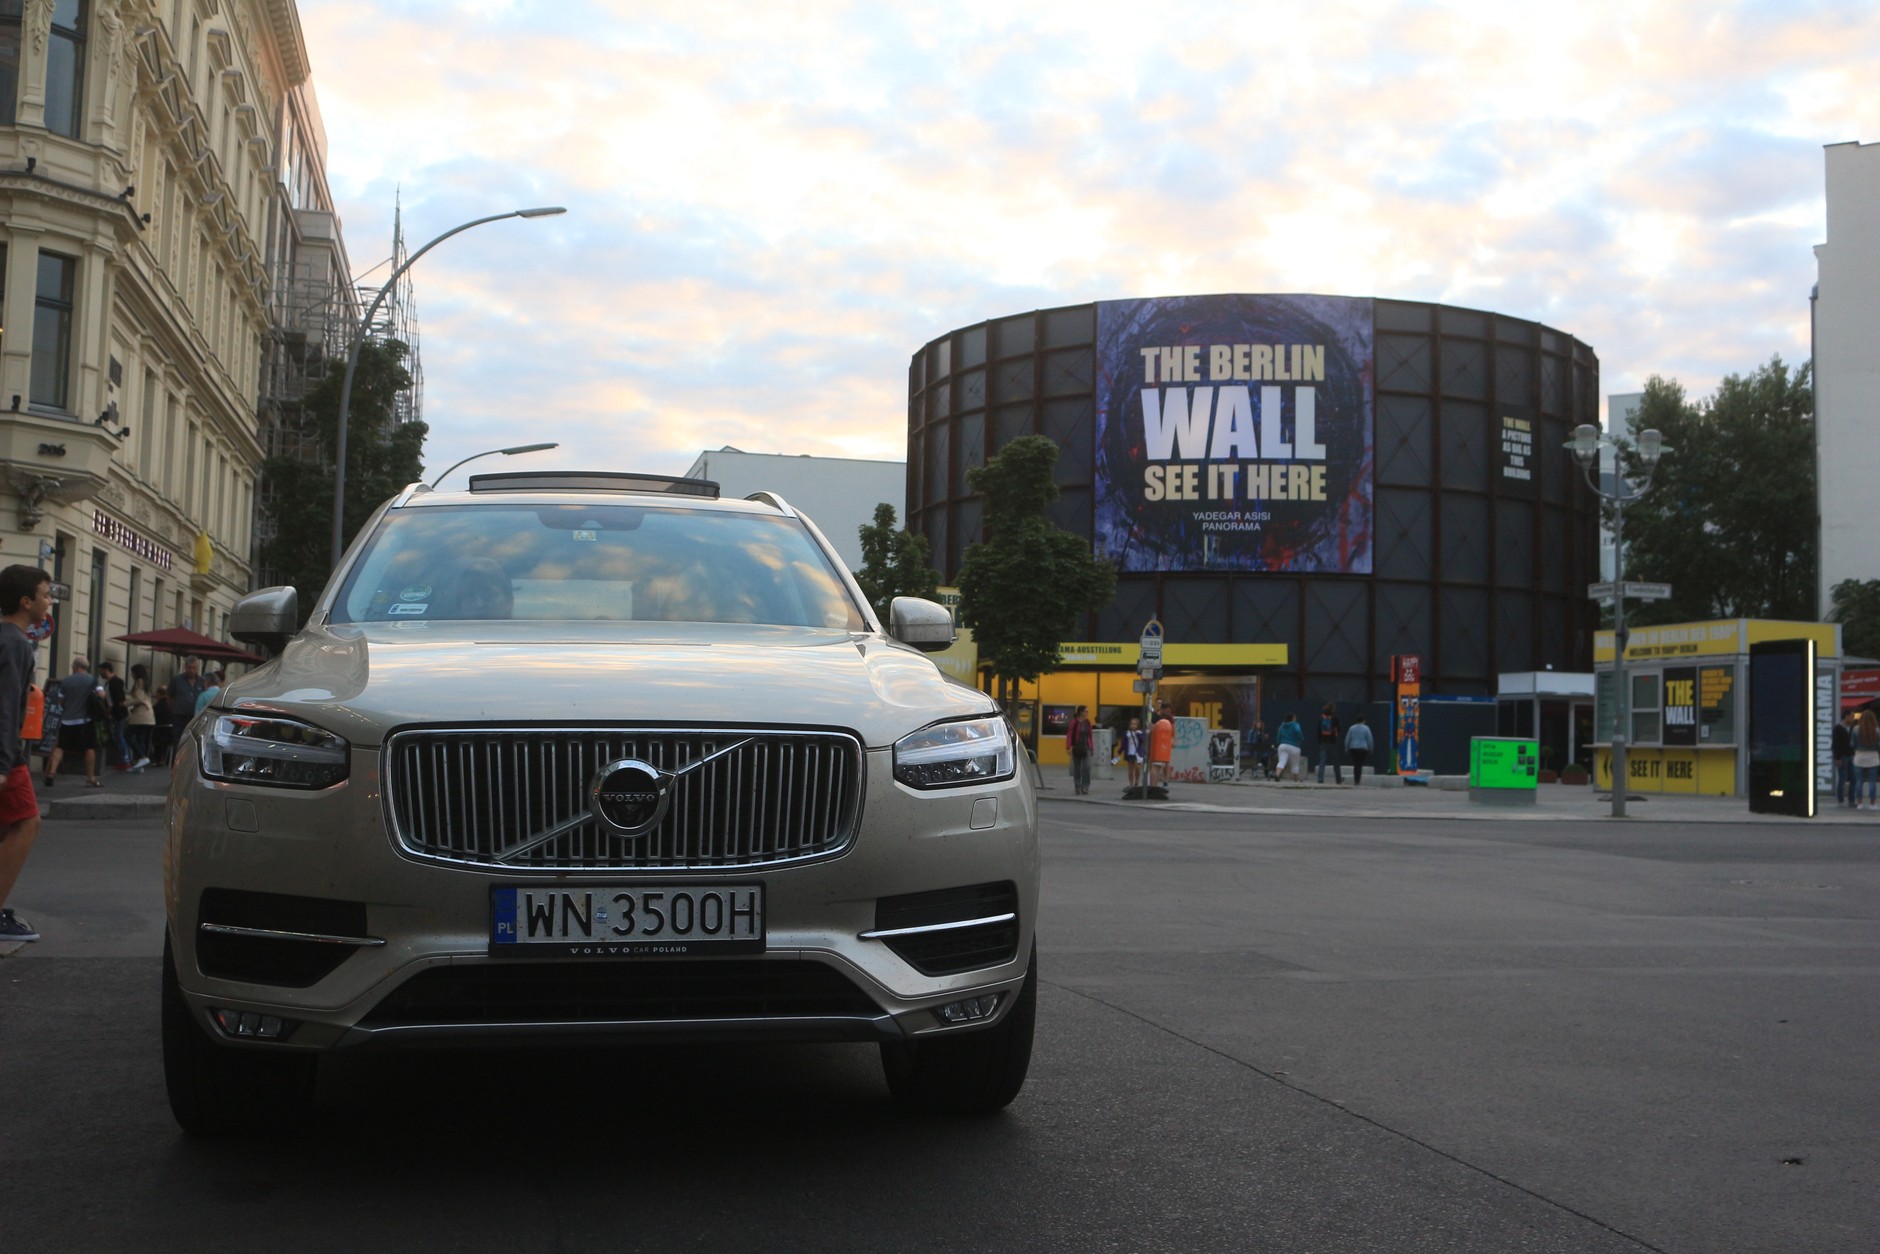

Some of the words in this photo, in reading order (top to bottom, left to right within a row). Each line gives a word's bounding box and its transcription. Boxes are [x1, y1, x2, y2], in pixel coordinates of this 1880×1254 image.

[1140, 345, 1201, 383] THE
[1209, 344, 1325, 382] BERLIN
[1140, 386, 1327, 460] WALL
[1507, 430, 1532, 443] PICTURE
[1144, 465, 1199, 501] SEE
[1208, 465, 1239, 500] IT
[1247, 465, 1327, 501] HERE
[1193, 512, 1241, 522] YADEGAR
[1244, 512, 1271, 521] ASISI
[1202, 522, 1261, 532] PANORAMA
[1666, 680, 1694, 706] THE
[1190, 703, 1223, 730] DIE
[1665, 706, 1695, 725] WALL
[1817, 675, 1833, 792] PANORAMA
[1630, 759, 1648, 777] SEE
[1650, 760, 1661, 778] IT
[1666, 760, 1694, 779] HERE
[603, 794, 655, 802] VOLVO
[525, 892, 592, 938] WN
[612, 891, 756, 936] 3500H
[498, 922, 514, 934] PL
